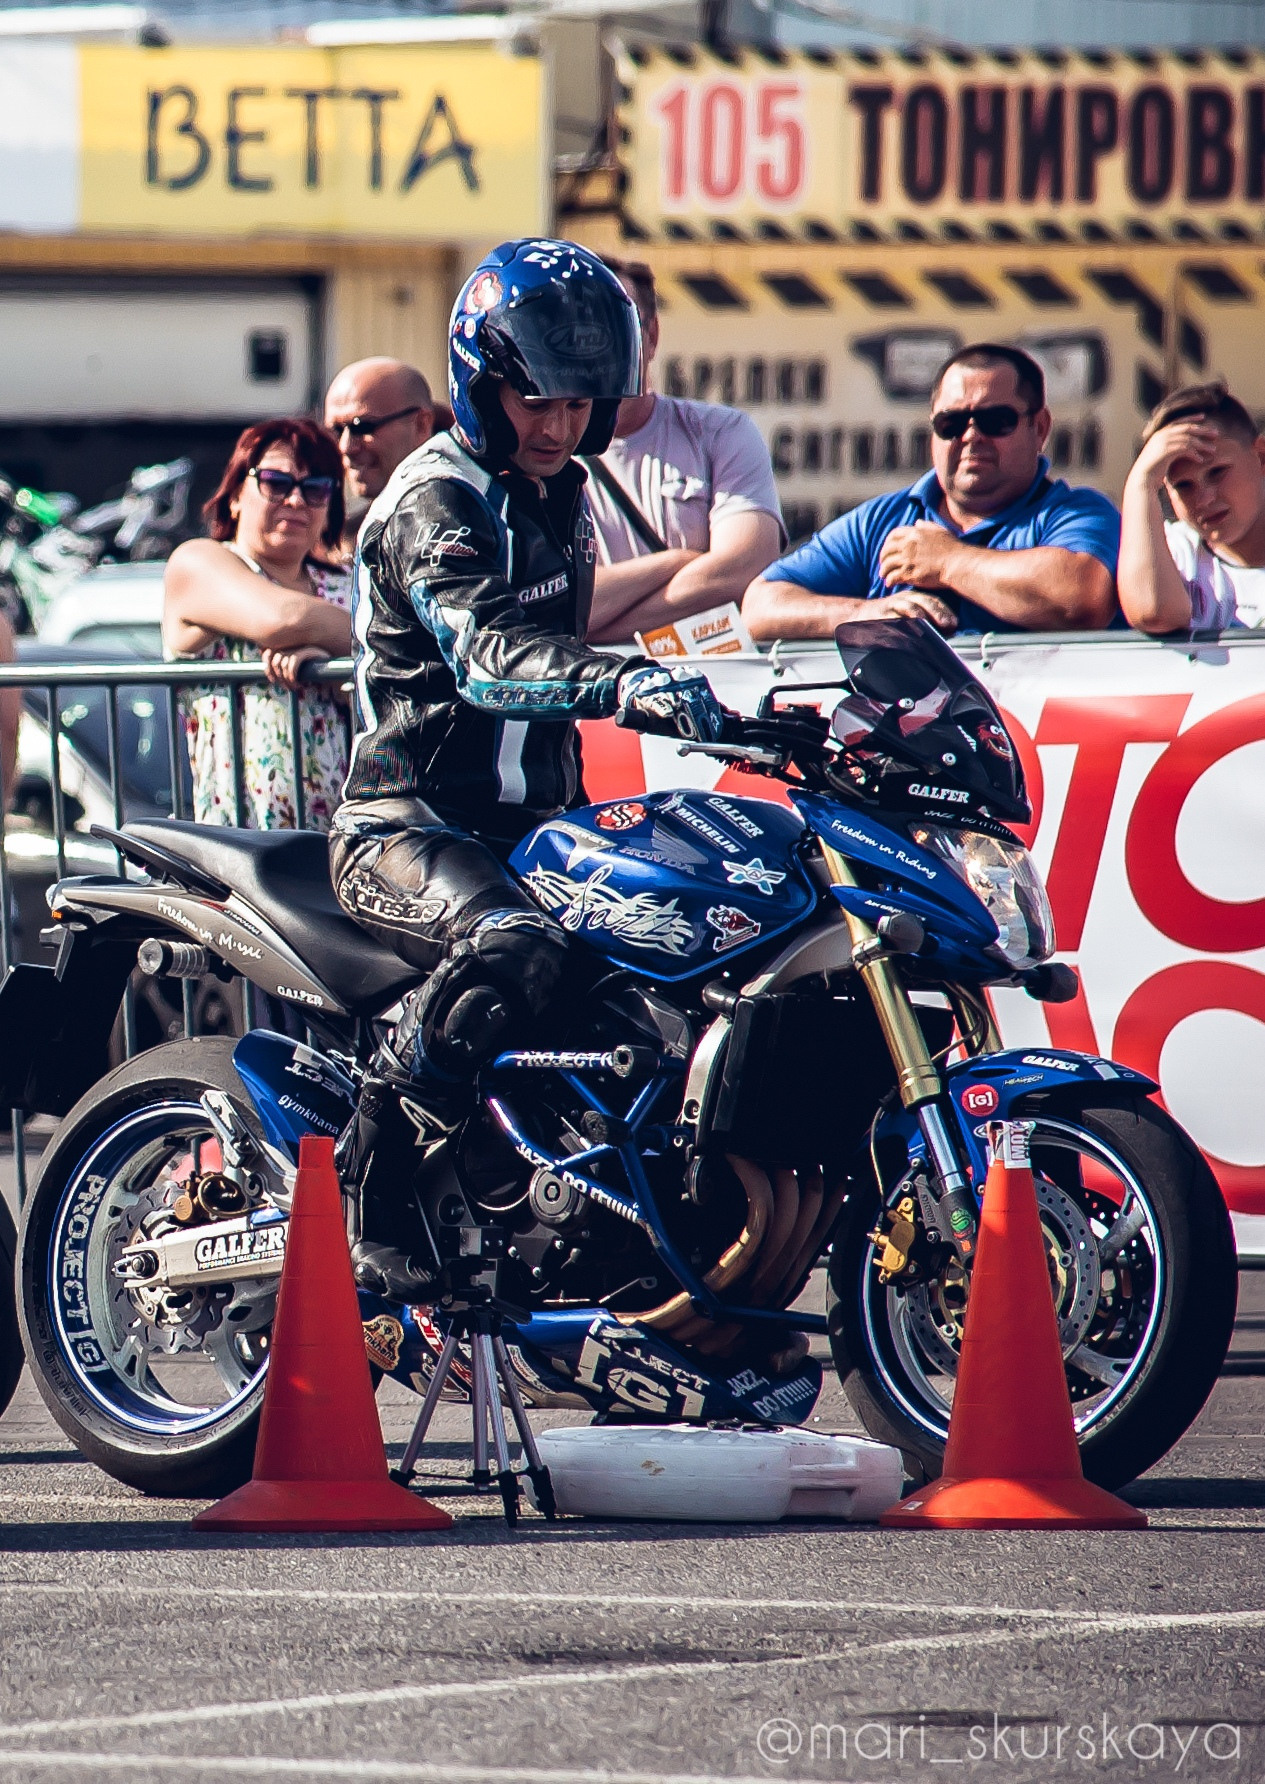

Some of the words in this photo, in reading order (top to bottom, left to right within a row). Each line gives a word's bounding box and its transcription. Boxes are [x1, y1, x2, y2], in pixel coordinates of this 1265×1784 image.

[146, 85, 480, 193] ВЕТТА
[655, 80, 808, 204] 105
[518, 572, 569, 604] GALFER
[908, 783, 969, 804] GALFER
[674, 806, 741, 855] MICHELIN
[708, 797, 765, 839] GALFER
[619, 844, 697, 876] HONDA
[830, 819, 878, 848] Freedom
[895, 850, 937, 880] Riding
[277, 985, 324, 1007] GALFER
[1021, 1055, 1081, 1072] GALFER
[277, 1094, 340, 1135] gymkhana
[63, 1174, 108, 1325] PROJECT
[197, 1226, 285, 1263] GALFER
